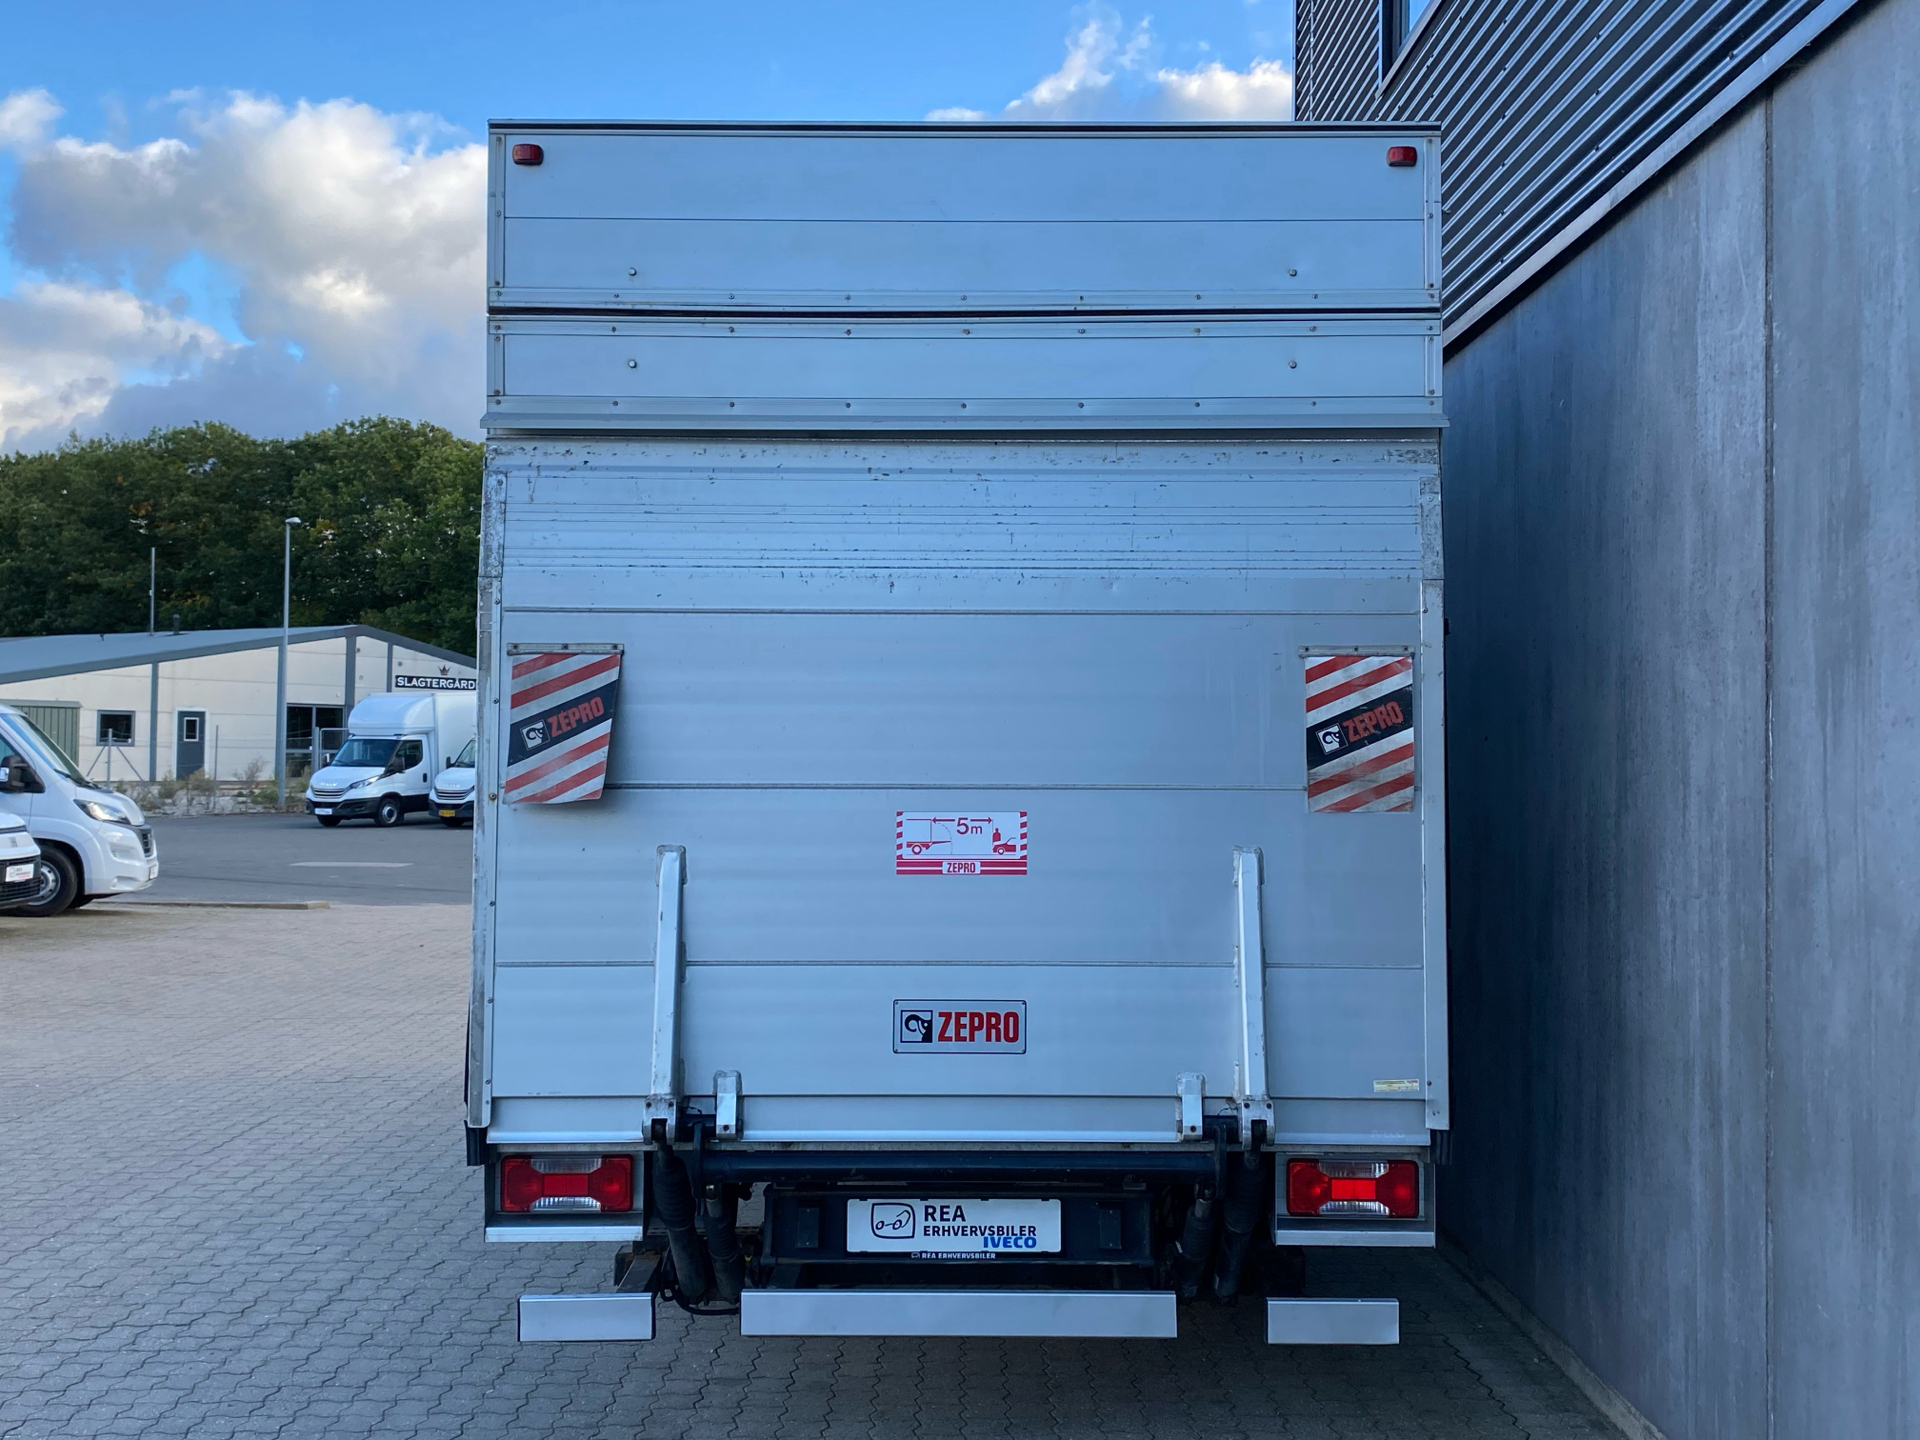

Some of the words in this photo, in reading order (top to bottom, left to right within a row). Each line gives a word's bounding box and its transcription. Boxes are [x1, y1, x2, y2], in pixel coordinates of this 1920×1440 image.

[547, 697, 604, 738] ZEPRO
[1343, 701, 1403, 742] ZEPRO
[947, 862, 976, 873] ZEPRO
[937, 1011, 1020, 1043] ZEPRO
[924, 1205, 966, 1222] REA
[923, 1225, 1037, 1237] ERHVERVSBILER
[983, 1236, 1037, 1248] IVECO
